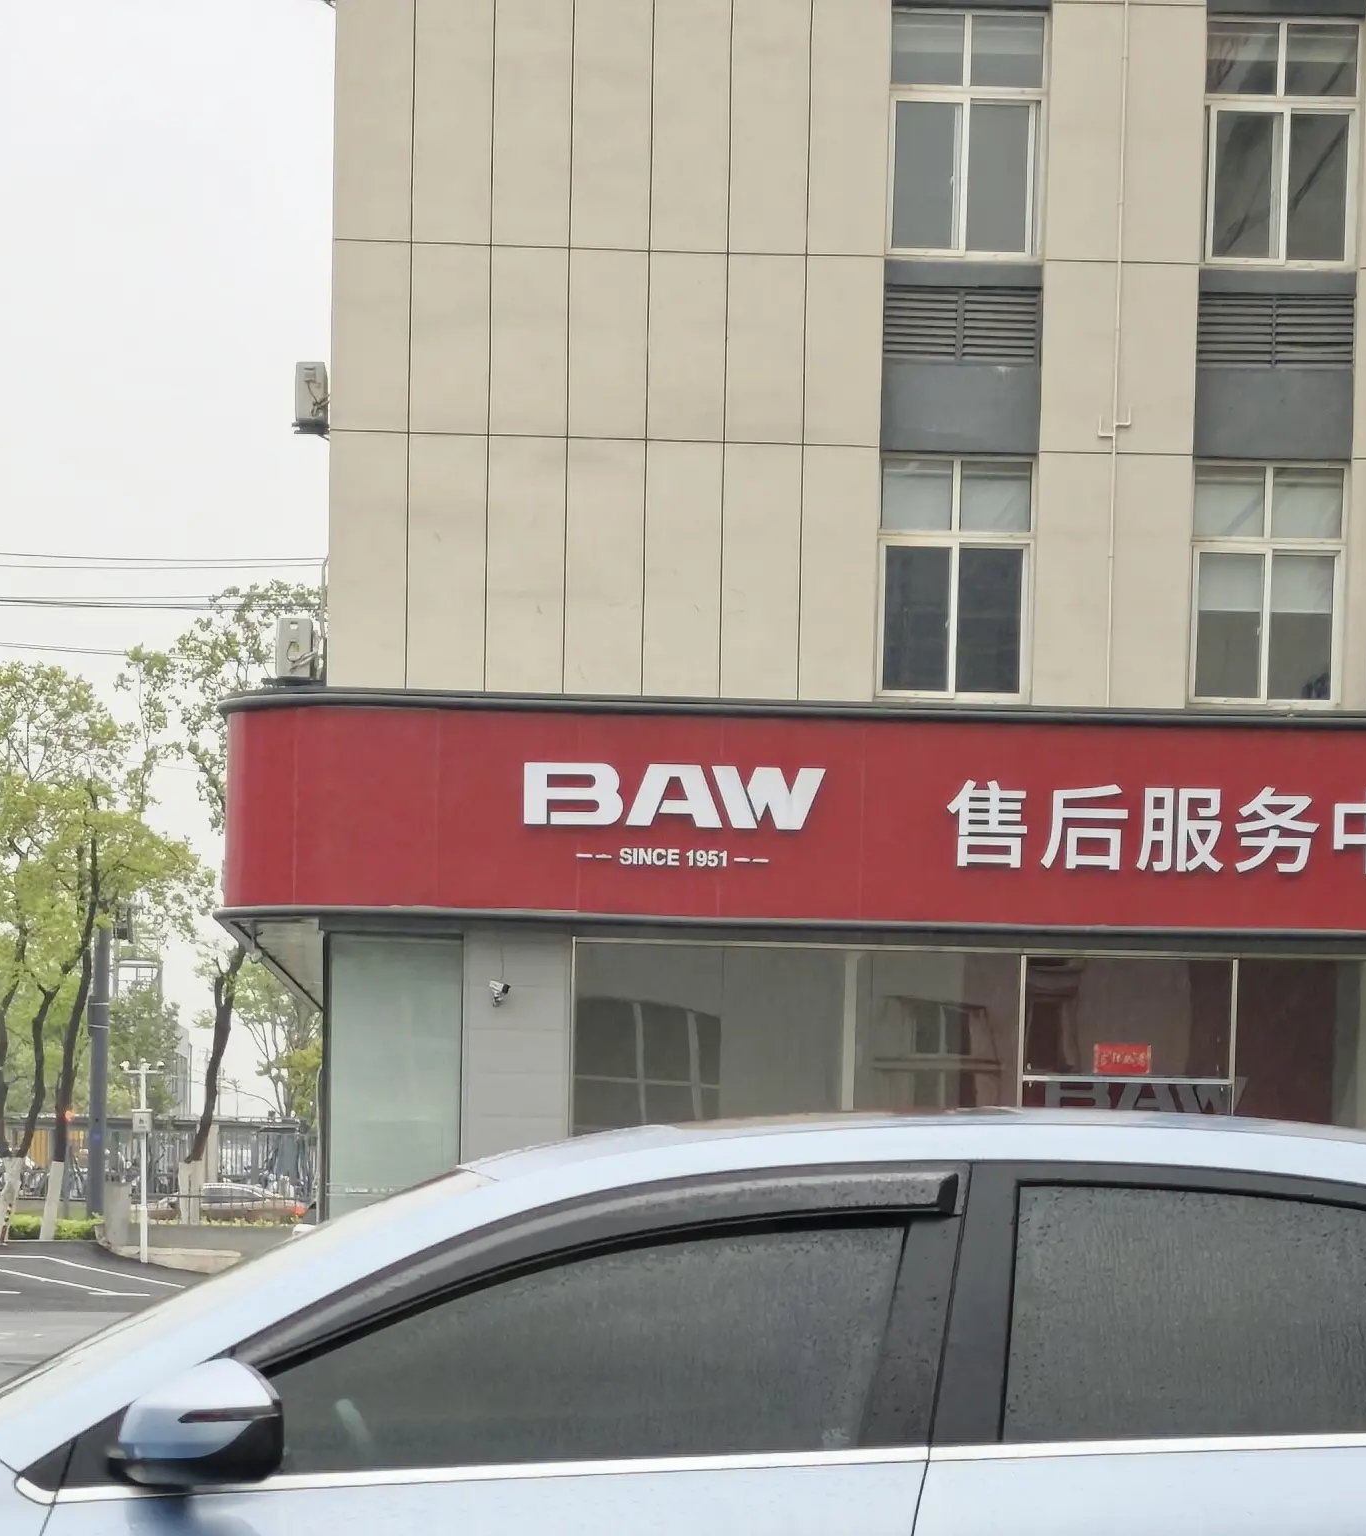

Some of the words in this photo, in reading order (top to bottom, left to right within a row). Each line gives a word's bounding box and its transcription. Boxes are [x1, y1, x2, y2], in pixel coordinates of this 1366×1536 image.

[523, 761, 827, 830] BAW
[619, 848, 680, 866] SINCE
[685, 850, 728, 867] 1951
